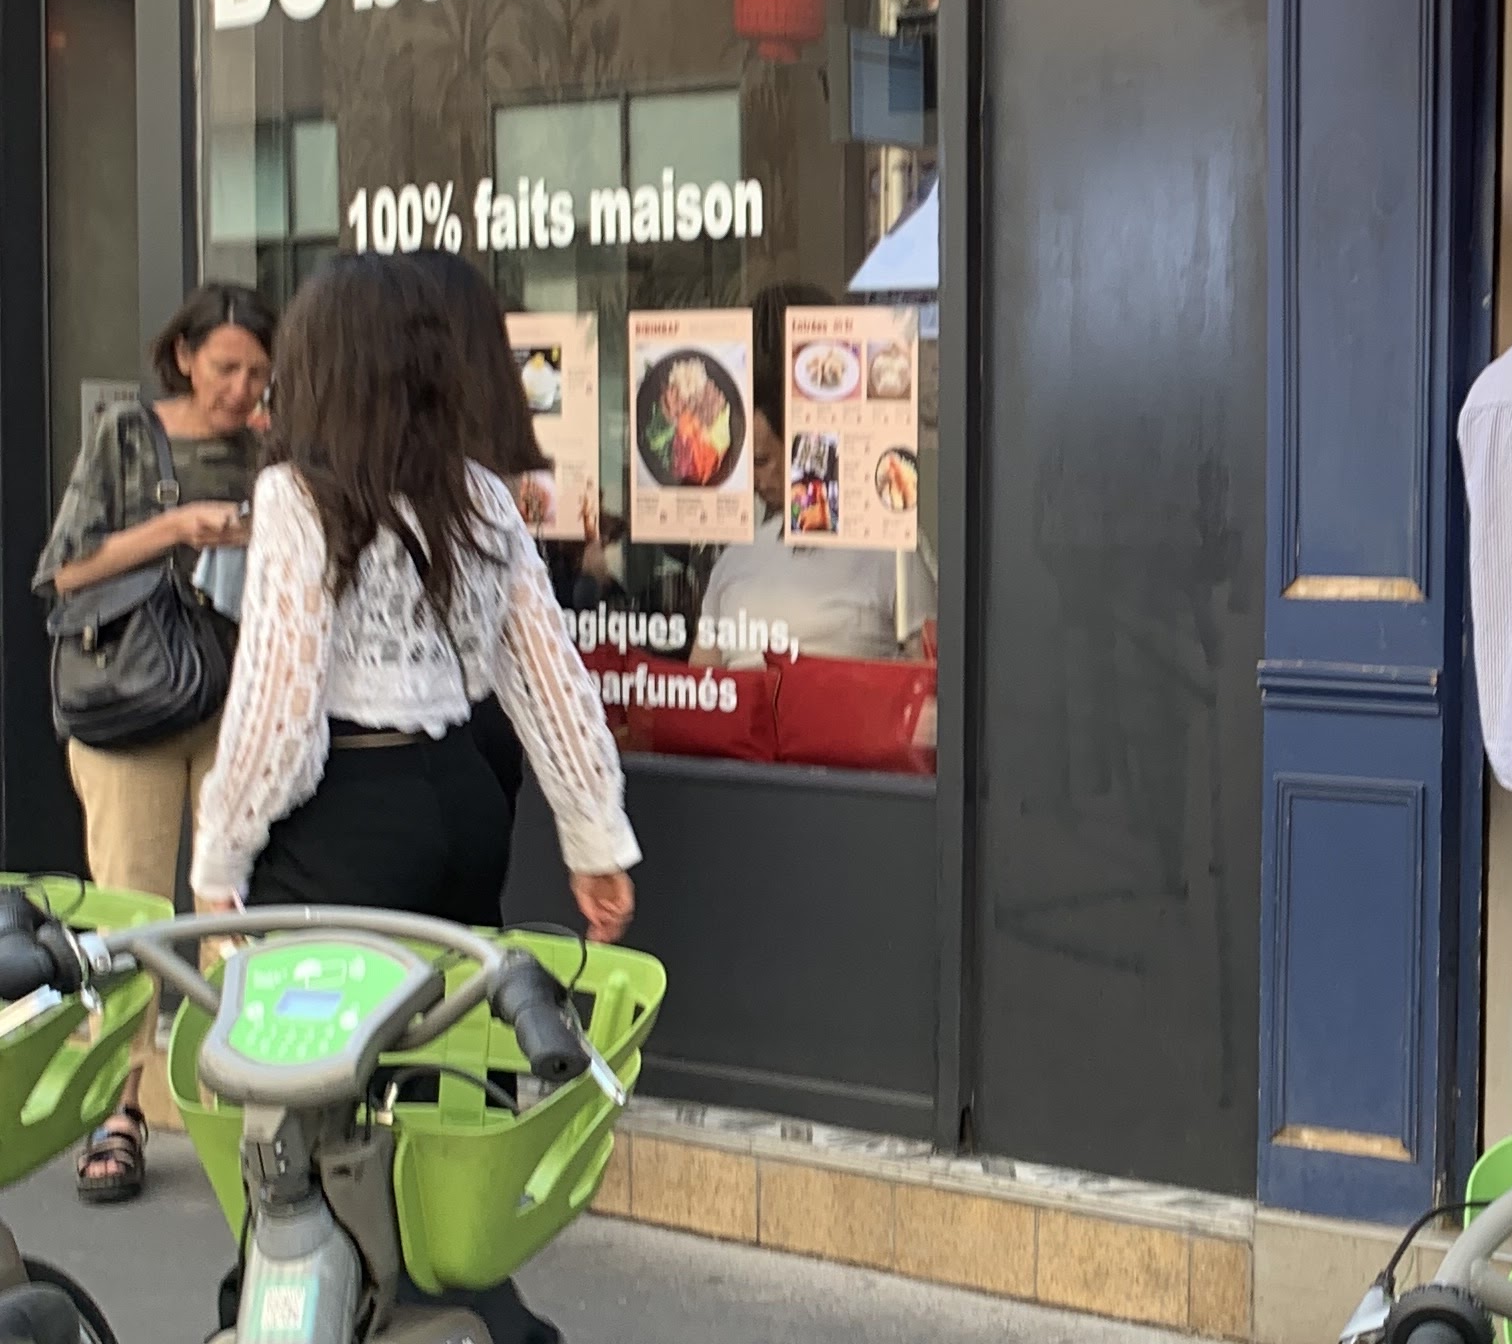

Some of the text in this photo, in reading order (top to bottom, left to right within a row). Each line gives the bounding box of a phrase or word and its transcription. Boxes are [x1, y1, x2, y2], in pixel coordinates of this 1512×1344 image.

[348, 166, 763, 256] 100% faits maison
[589, 663, 738, 713] arfumés
